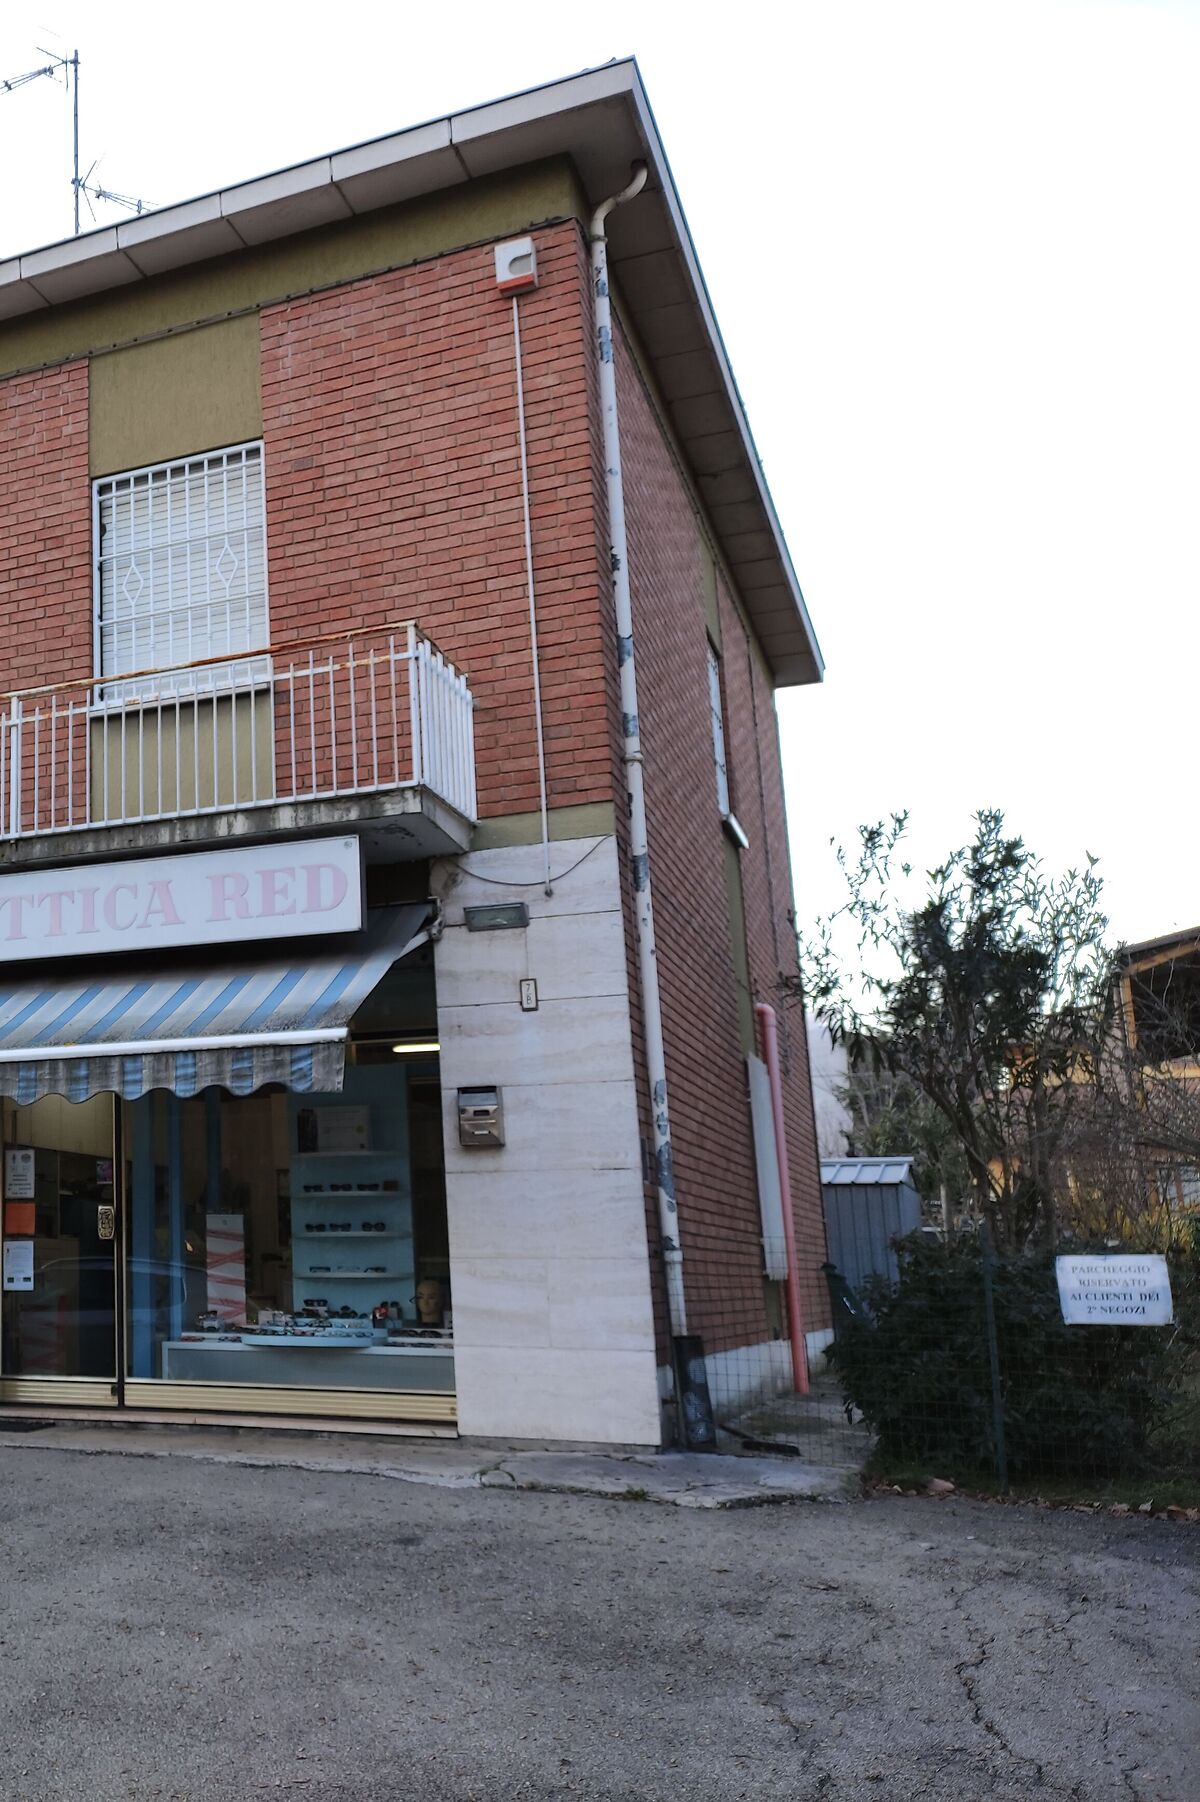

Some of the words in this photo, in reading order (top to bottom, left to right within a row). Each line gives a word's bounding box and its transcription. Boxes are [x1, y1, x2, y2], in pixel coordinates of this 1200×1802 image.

[204, 863, 349, 924] RED
[1071, 1265, 1151, 1274] PARCHEGGIO
[1079, 1279, 1147, 1288] RISERVATO
[1070, 1292, 1082, 1301] AI
[1085, 1292, 1133, 1301] CLIENTI
[1139, 1291, 1160, 1302] DEI
[1100, 1305, 1146, 1315] NEGOZI
